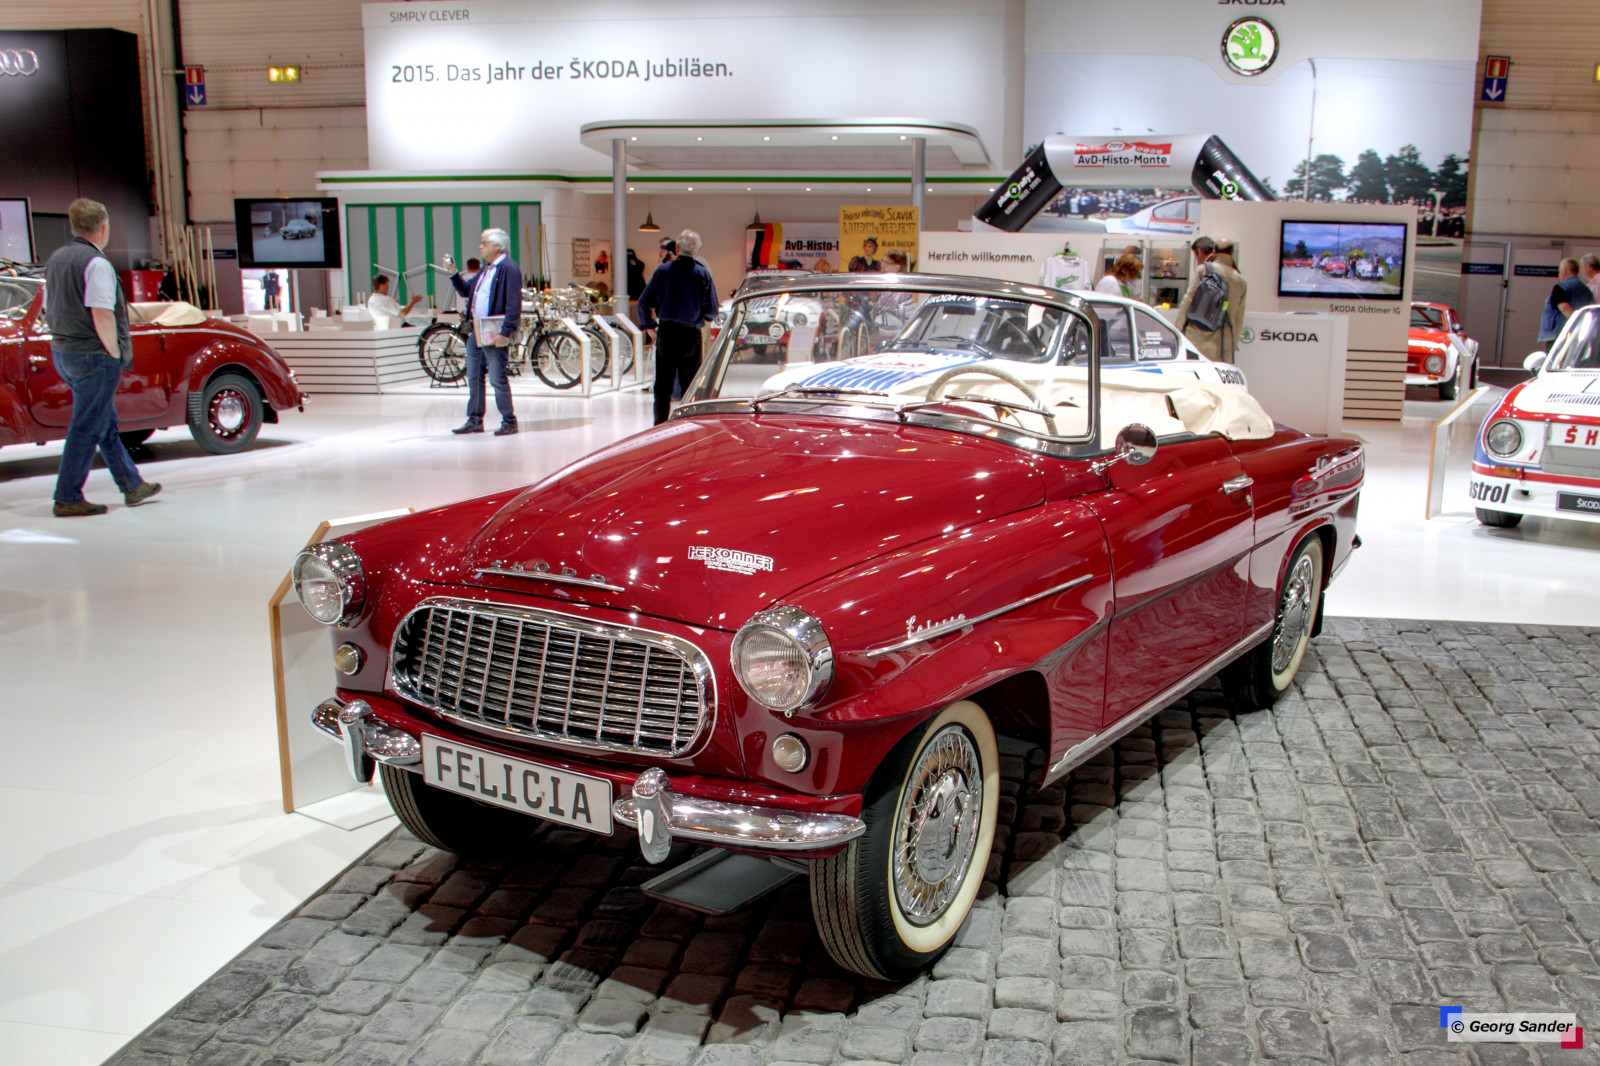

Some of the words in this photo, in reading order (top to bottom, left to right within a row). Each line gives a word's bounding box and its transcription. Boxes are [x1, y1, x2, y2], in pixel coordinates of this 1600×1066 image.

[389, 11, 427, 23] SIMPLY
[429, 9, 470, 22] CLEVER
[392, 65, 440, 83] 2015.
[447, 64, 481, 81] Das
[486, 61, 525, 84] Jahr
[531, 60, 563, 80] der
[569, 57, 640, 79] ŠKODA
[644, 57, 733, 82] Jubiläen.
[1078, 154, 1167, 165] AvD-Histo-Monte
[785, 240, 839, 251] AvD-Histo-
[928, 251, 969, 262] Herzlich
[971, 251, 1036, 264] willkommen.
[1329, 303, 1356, 313] ŠKODA
[1358, 305, 1391, 315] Oldtimer
[1392, 307, 1401, 315] IG
[1260, 329, 1319, 342] ŠKODA
[1576, 497, 1600, 511] ŠKOD
[687, 545, 774, 572] HERKOMMER
[436, 745, 592, 824] FELICIA
